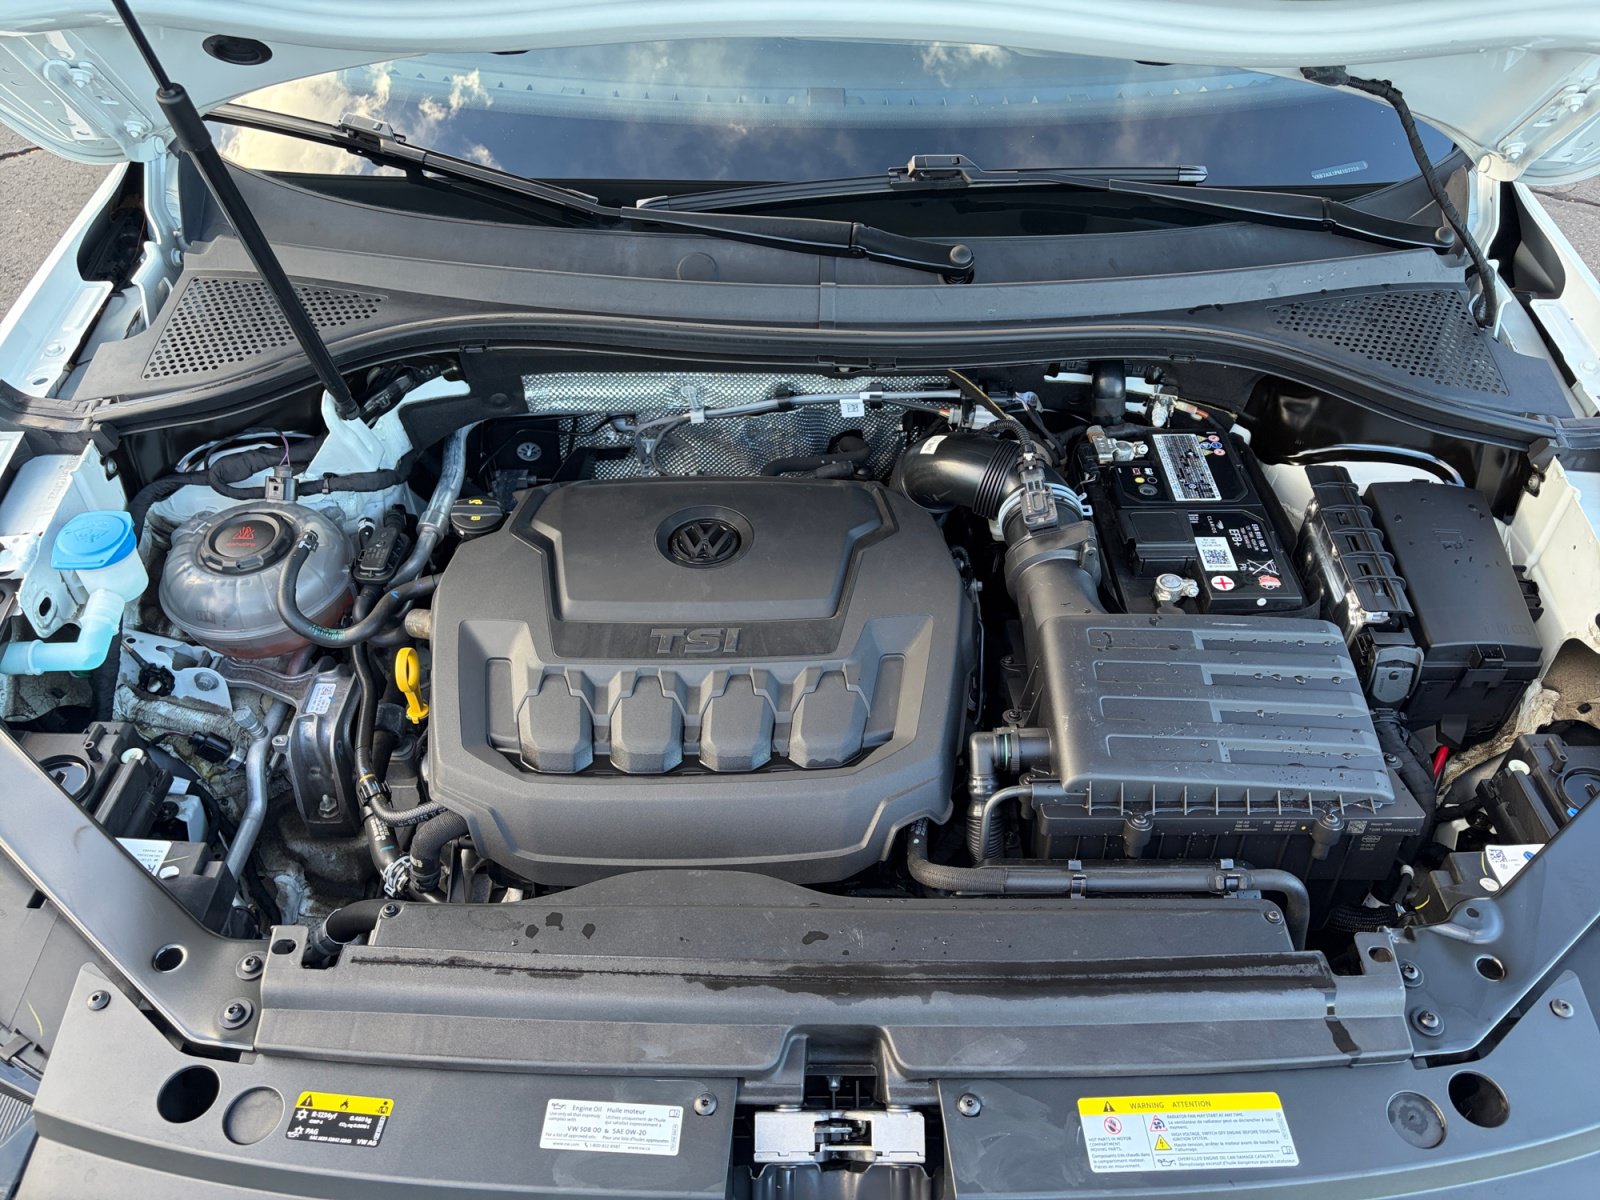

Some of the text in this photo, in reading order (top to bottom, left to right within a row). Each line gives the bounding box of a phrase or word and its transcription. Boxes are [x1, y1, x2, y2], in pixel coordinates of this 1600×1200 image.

[1207, 516, 1217, 534] CLARIOS
[1228, 528, 1242, 547] EFB+
[650, 627, 742, 654] TSI
[311, 1111, 338, 1120] R-1234yf
